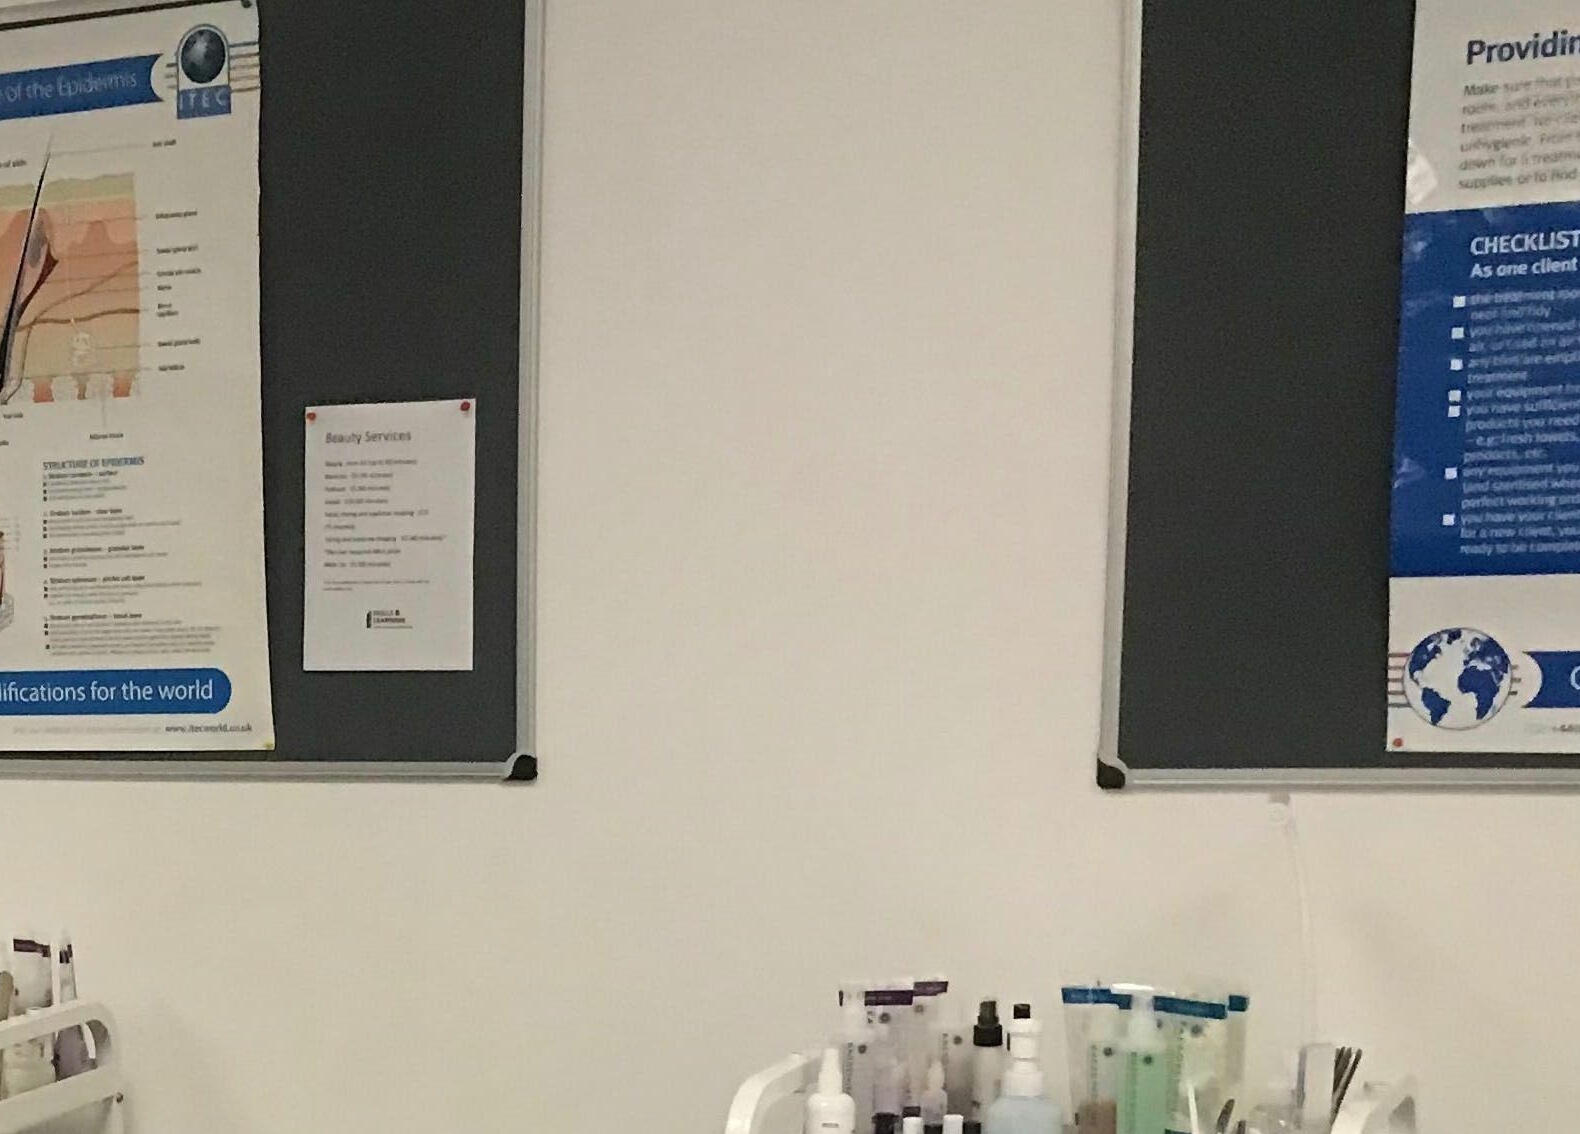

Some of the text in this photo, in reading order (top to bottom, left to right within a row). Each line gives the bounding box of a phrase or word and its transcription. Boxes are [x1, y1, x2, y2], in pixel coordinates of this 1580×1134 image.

[5, 82, 21, 102] of
[25, 79, 54, 100] the
[56, 71, 137, 98] Epidermis
[1463, 83, 1499, 97] Make
[178, 88, 228, 111] ITEC
[1533, 171, 1548, 183] to
[1470, 230, 1580, 256] CHECKLIST
[1469, 256, 1578, 279] As one client
[325, 429, 412, 445] Beauty Services
[90, 680, 117, 701] for
[121, 681, 153, 700] the
[158, 679, 214, 700] world
